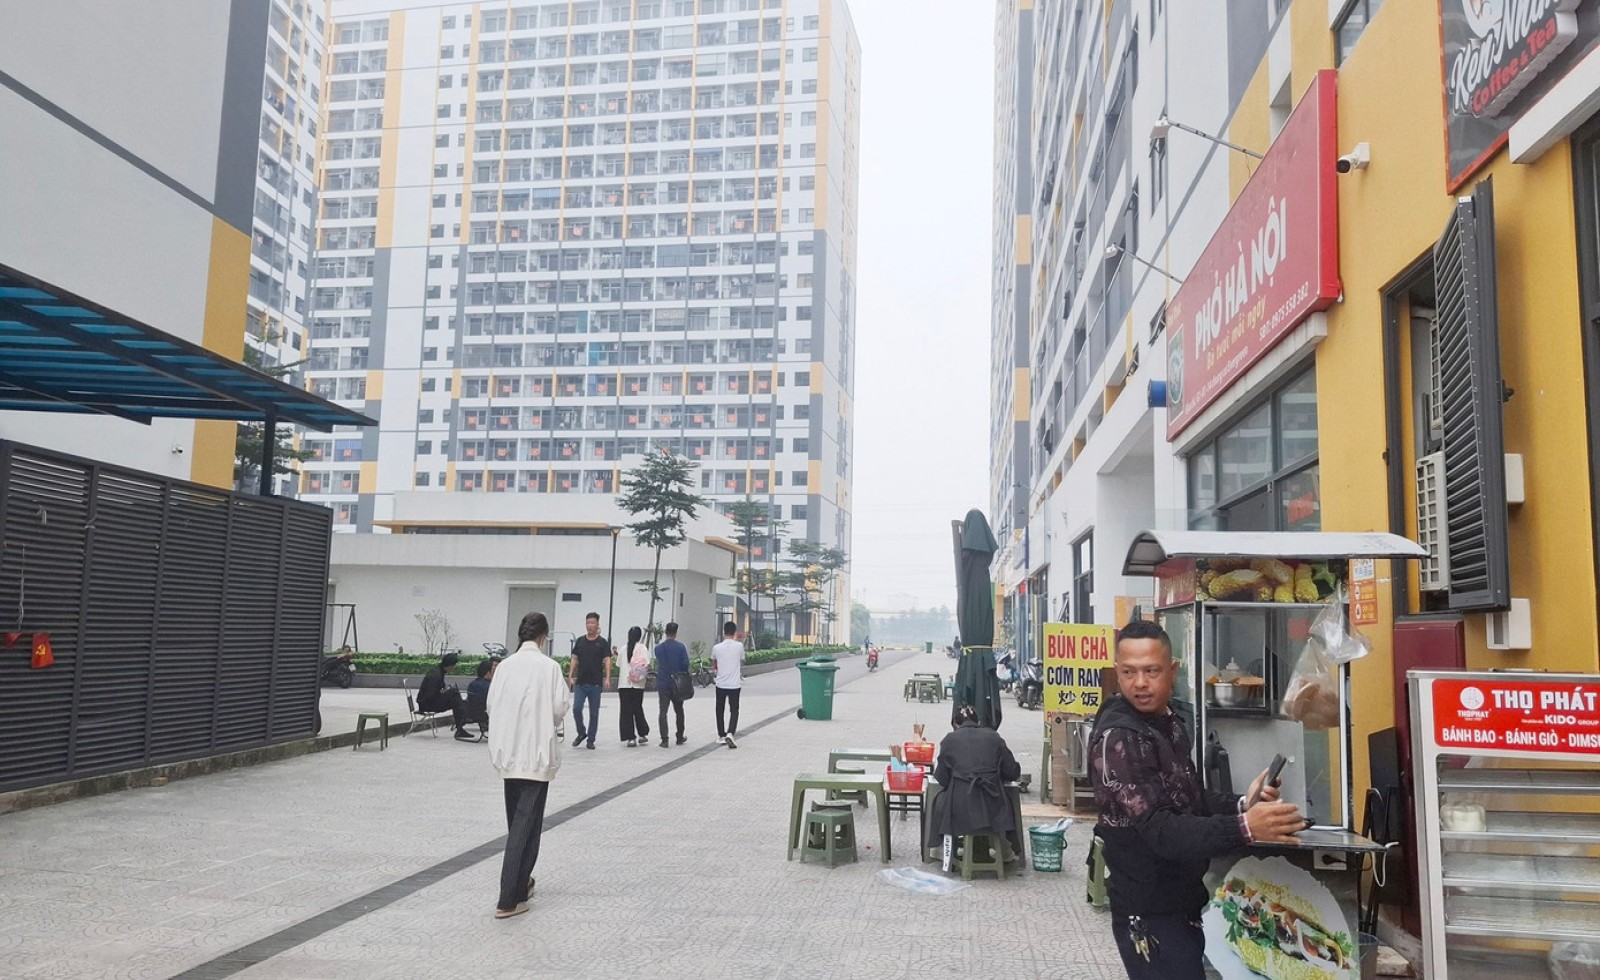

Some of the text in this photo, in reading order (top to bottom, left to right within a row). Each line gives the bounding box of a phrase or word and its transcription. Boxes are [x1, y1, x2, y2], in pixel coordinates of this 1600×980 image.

[1473, 16, 1556, 112] Coffee & Tea
[1195, 269, 1222, 360] PHỞ
[1225, 240, 1248, 325] HÀ
[1250, 195, 1286, 295] NỘI
[1247, 294, 1266, 329] ngày
[1047, 628, 1108, 660] BÚN CHẢ
[1047, 665, 1074, 686] CƠM
[1058, 690, 1099, 707] 炒饭
[1491, 686, 1598, 715] THỌ PHÁT
[1544, 714, 1577, 725] KIDO
[1442, 725, 1472, 742] BÁNH
[1474, 729, 1496, 743] BAO
[1506, 727, 1537, 745] BÁNH
[1539, 728, 1559, 746] GIÒ
